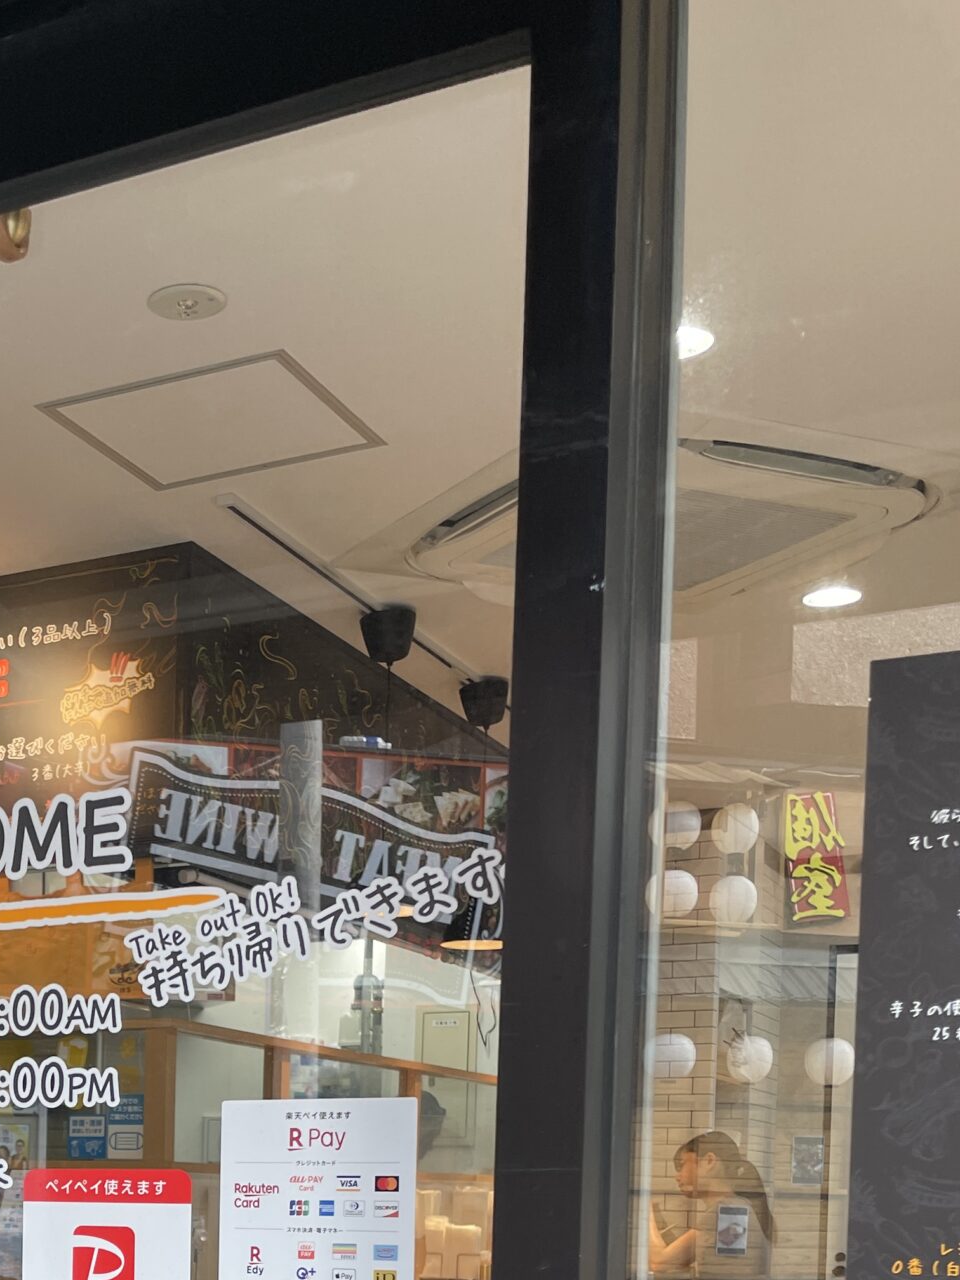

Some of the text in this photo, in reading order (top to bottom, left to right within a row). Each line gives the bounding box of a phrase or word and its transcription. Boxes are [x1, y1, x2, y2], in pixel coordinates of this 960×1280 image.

[140, 853, 497, 1001] 持ち帰りできます
[129, 934, 186, 958] Take
[200, 909, 240, 936] out
[285, 1111, 351, 1120] 楽天ペイ使えます
[308, 1128, 346, 1150] Pay
[45, 1179, 167, 1196] ペイペイ使えます
[234, 1183, 279, 1197] Rakuten
[340, 1180, 359, 1188] VISA
[234, 1198, 260, 1209] Card
[246, 1265, 264, 1276] Edy
[340, 1273, 353, 1280] Pay
